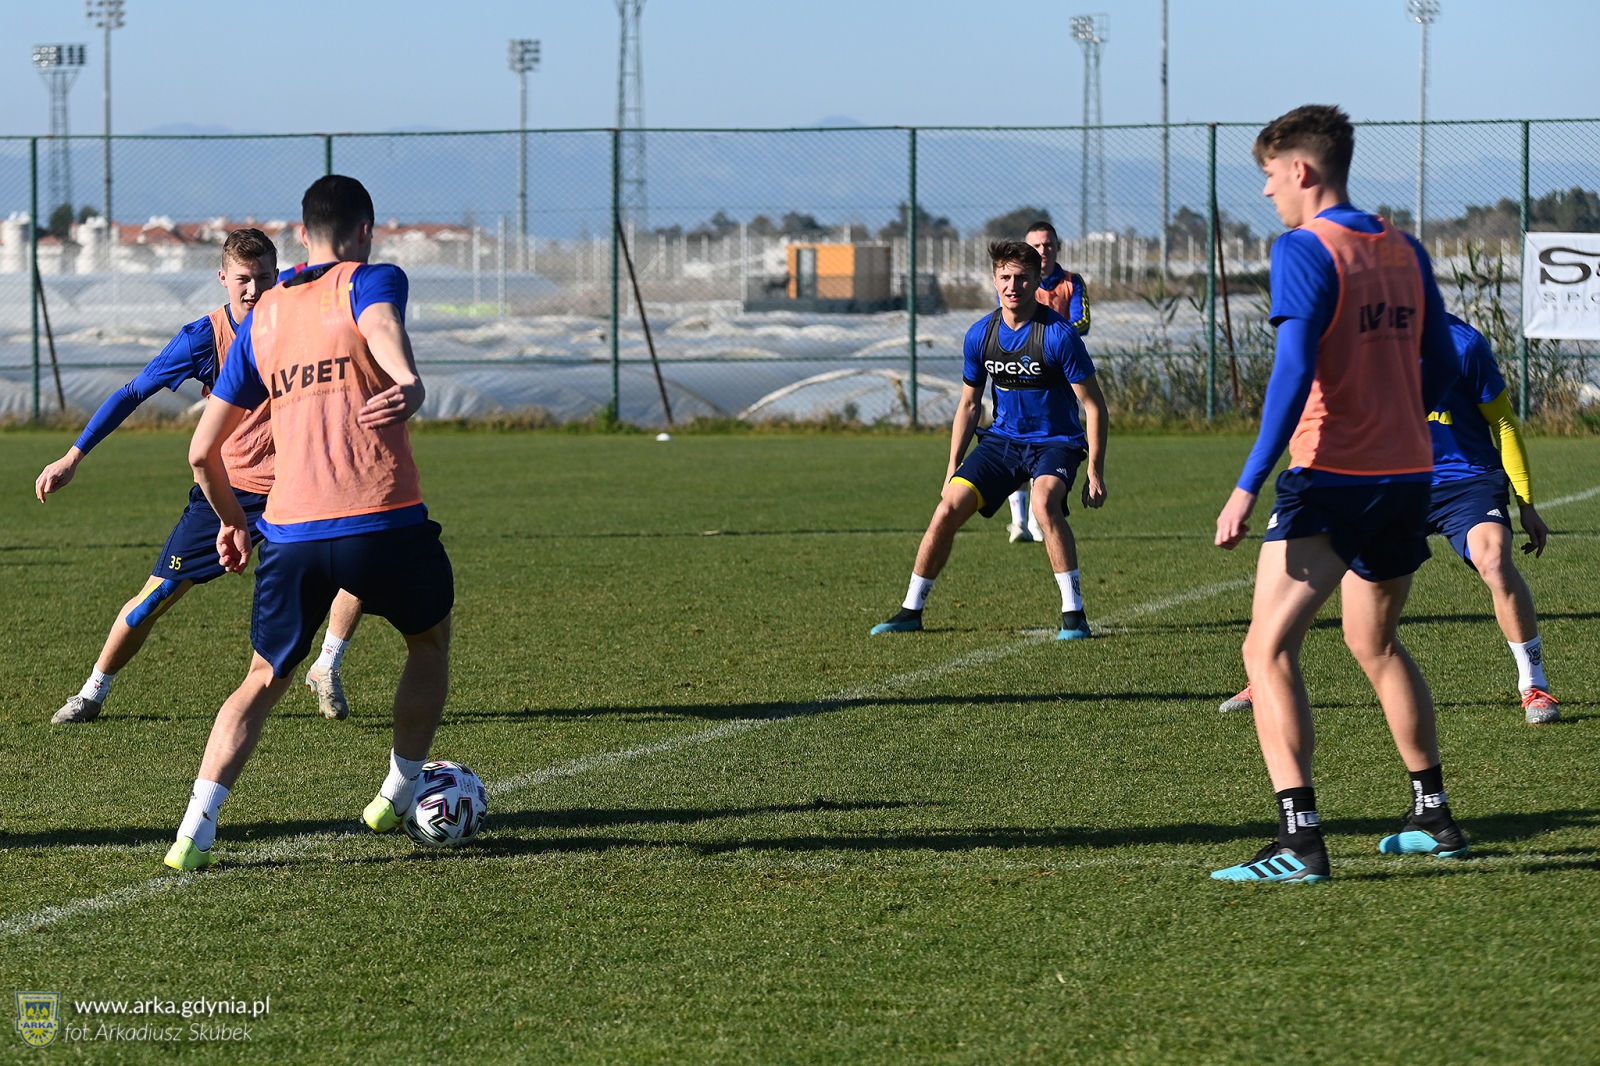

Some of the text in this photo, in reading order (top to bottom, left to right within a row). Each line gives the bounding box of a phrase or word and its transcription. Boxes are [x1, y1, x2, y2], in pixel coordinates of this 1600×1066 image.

[1538, 246, 1600, 285] S
[984, 359, 1043, 376] GPEXE
[168, 555, 183, 571] 35
